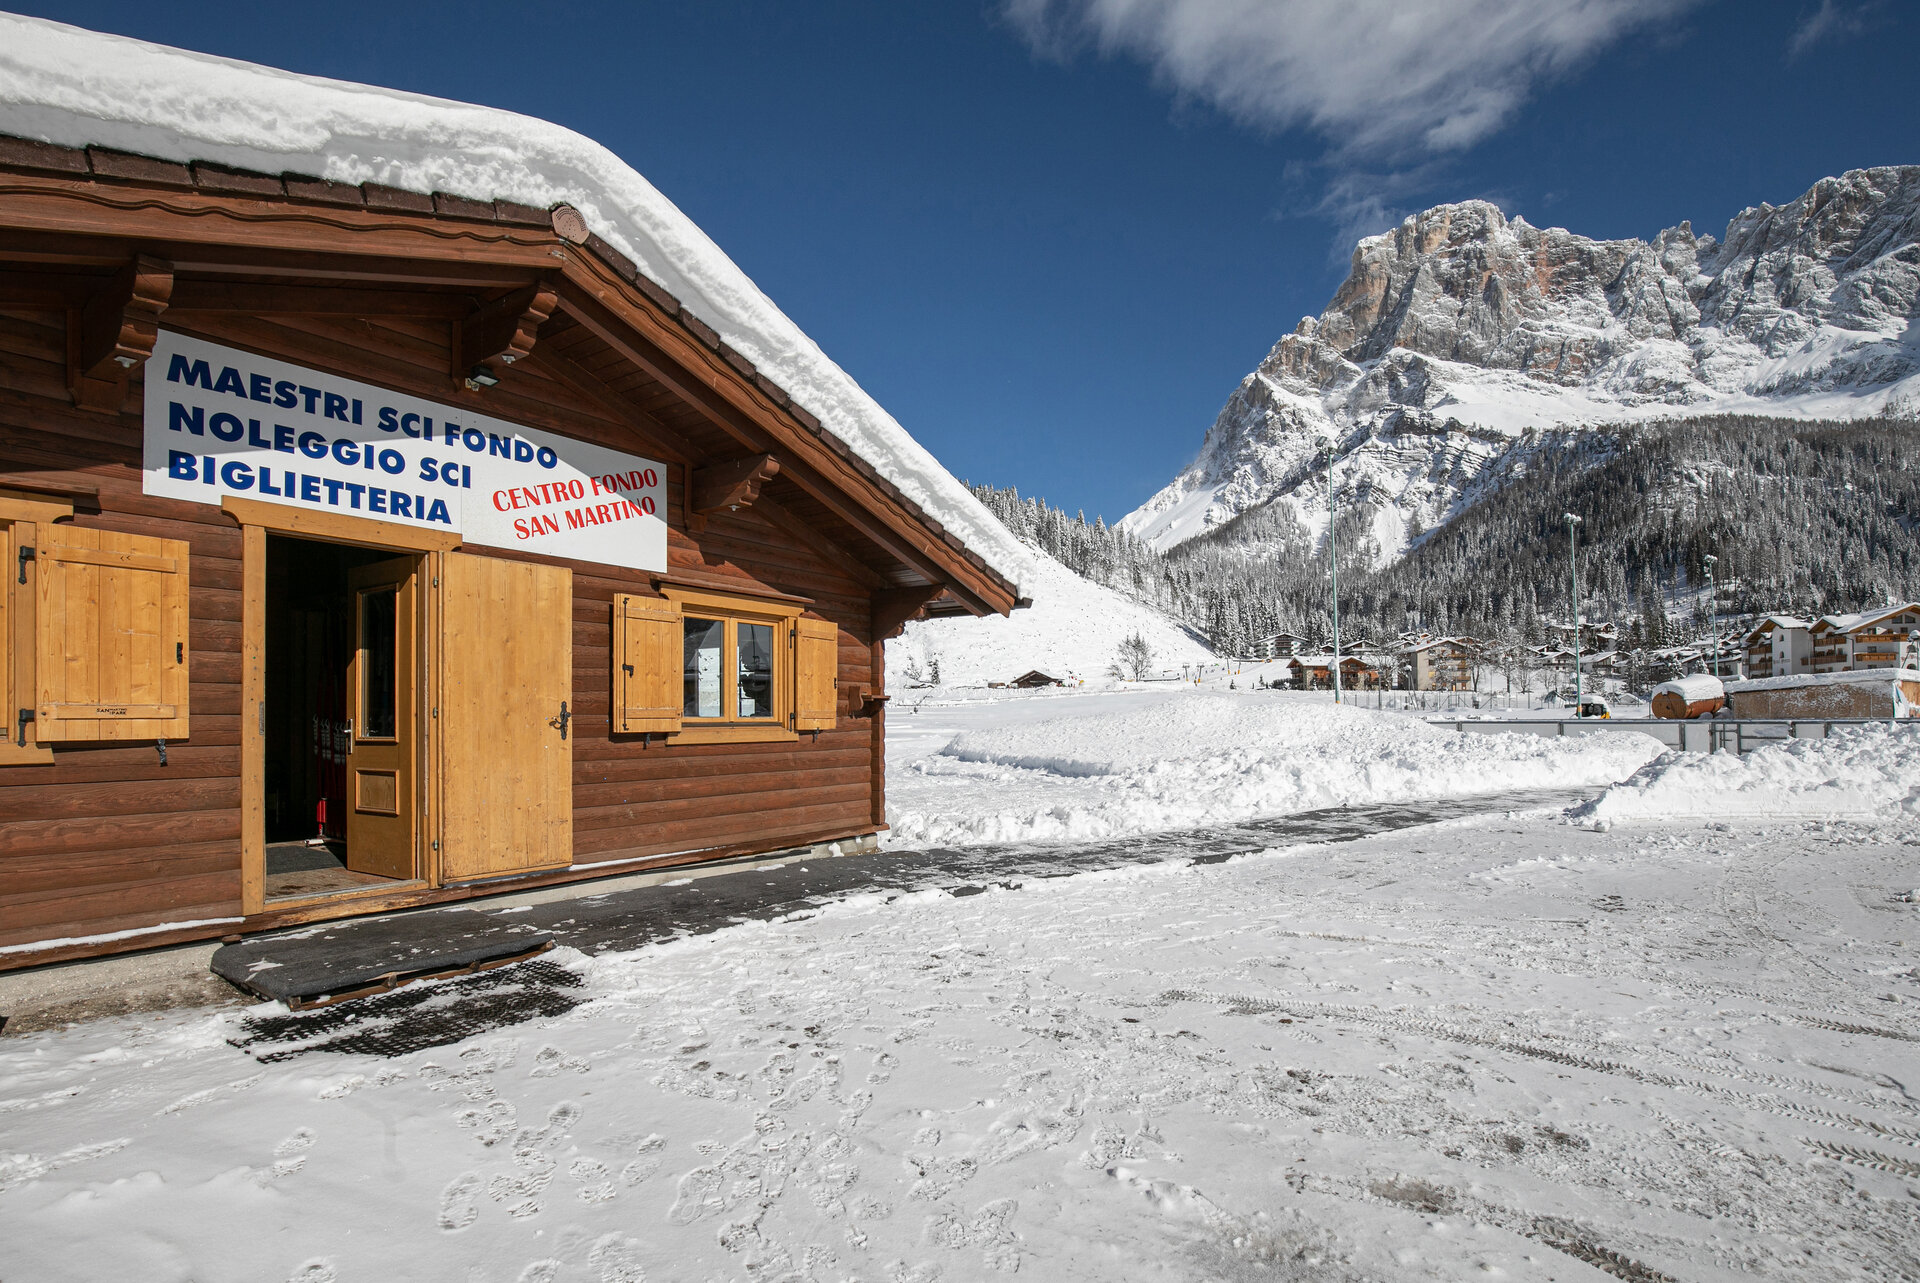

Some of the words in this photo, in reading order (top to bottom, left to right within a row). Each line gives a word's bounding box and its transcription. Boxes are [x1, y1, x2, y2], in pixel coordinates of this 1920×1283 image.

[168, 353, 363, 425] MAESTRI
[378, 406, 433, 442] SCI
[445, 423, 558, 470] FONDO
[168, 402, 406, 475] NOLEGGIO
[419, 456, 471, 489] SCI
[168, 449, 452, 525] BIGLIETTERIA
[492, 478, 585, 512] CENTRO
[590, 467, 659, 497] FONDO
[513, 514, 560, 540] SAN
[565, 495, 656, 529] MARTINO
